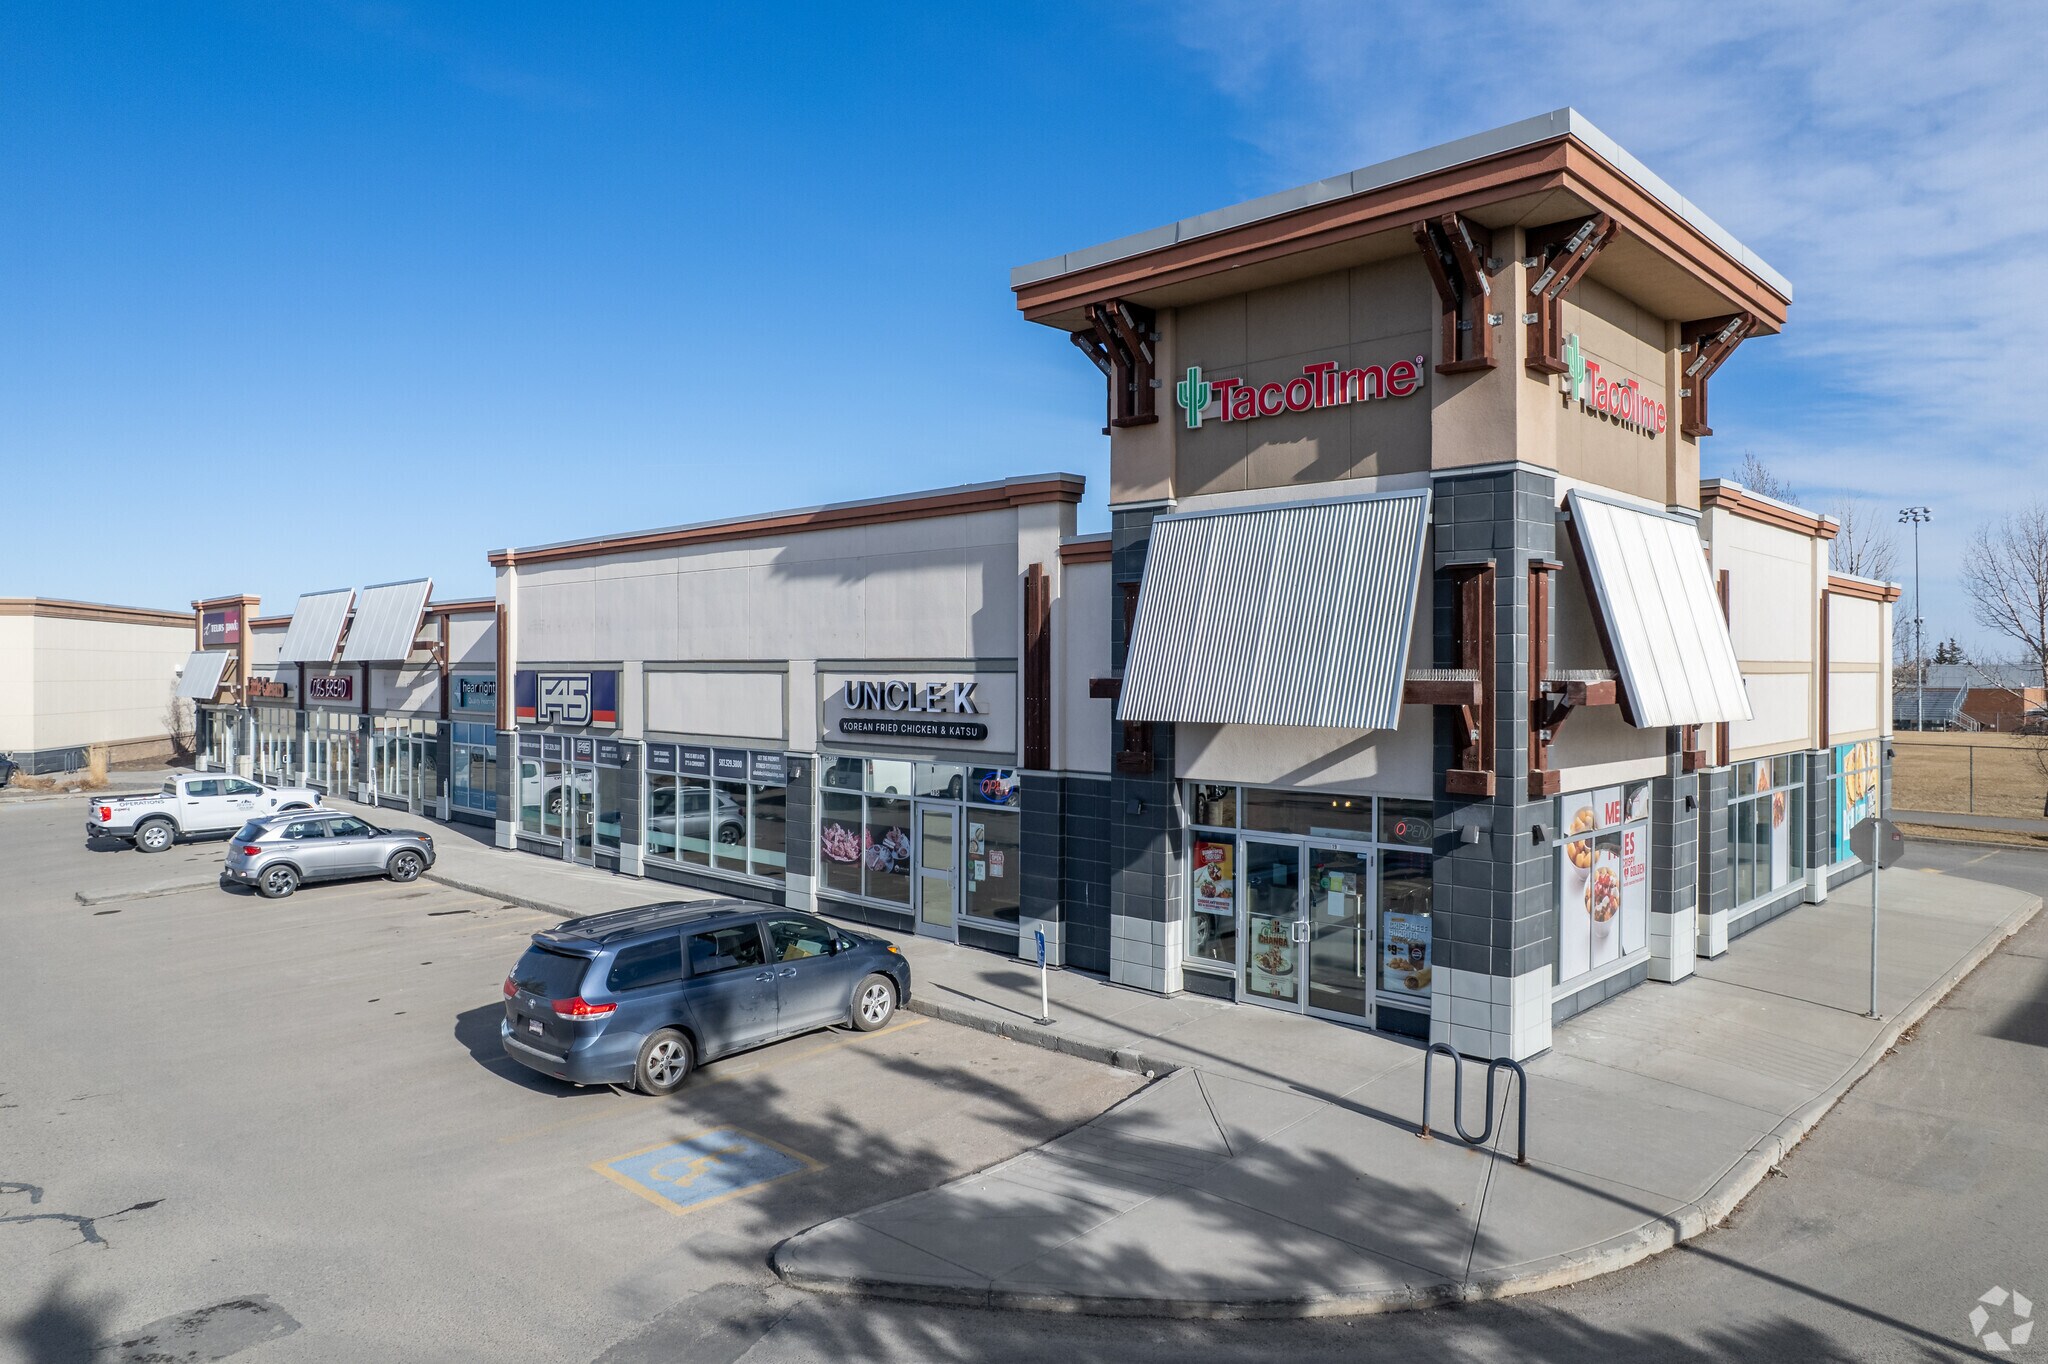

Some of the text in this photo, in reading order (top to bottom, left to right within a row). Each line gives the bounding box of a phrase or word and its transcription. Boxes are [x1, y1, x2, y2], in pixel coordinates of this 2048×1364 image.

[1211, 360, 1419, 422] TacoTime
[1586, 360, 1667, 433] TacoTime
[325, 678, 347, 698] BREAD
[462, 681, 496, 696] hear right
[844, 680, 979, 714] UNCLE K
[539, 674, 591, 724] F45
[843, 722, 978, 737] KOREAN FRIED CHICKEN & KATSU
[982, 779, 1009, 796] OPEN
[1396, 821, 1430, 839] OPEN
[1410, 923, 1429, 933] BEEF
[1258, 934, 1289, 949] CHANGA
